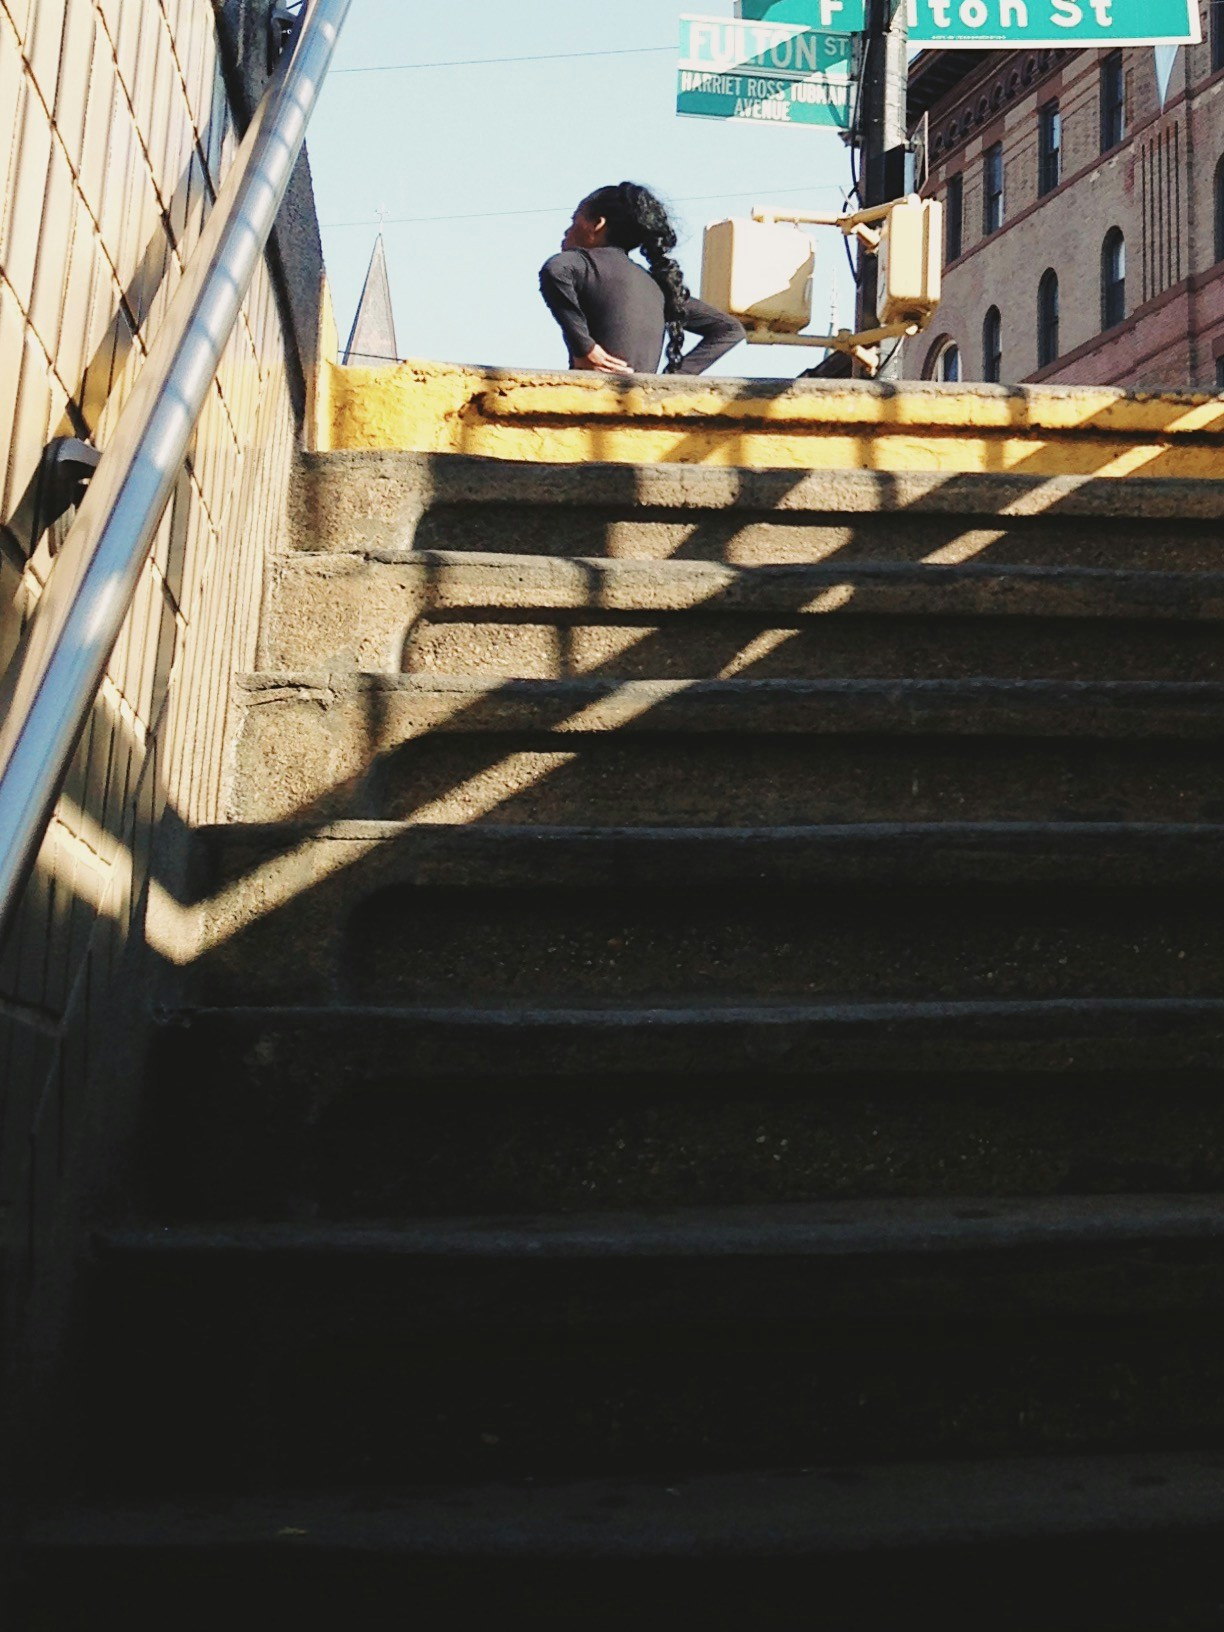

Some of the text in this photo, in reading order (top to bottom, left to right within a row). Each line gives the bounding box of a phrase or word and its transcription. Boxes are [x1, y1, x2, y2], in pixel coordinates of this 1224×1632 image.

[691, 25, 849, 70] FULTON ST
[681, 72, 848, 105] HARRIET ROSS TUBMAN
[735, 99, 791, 120] AVENUE
